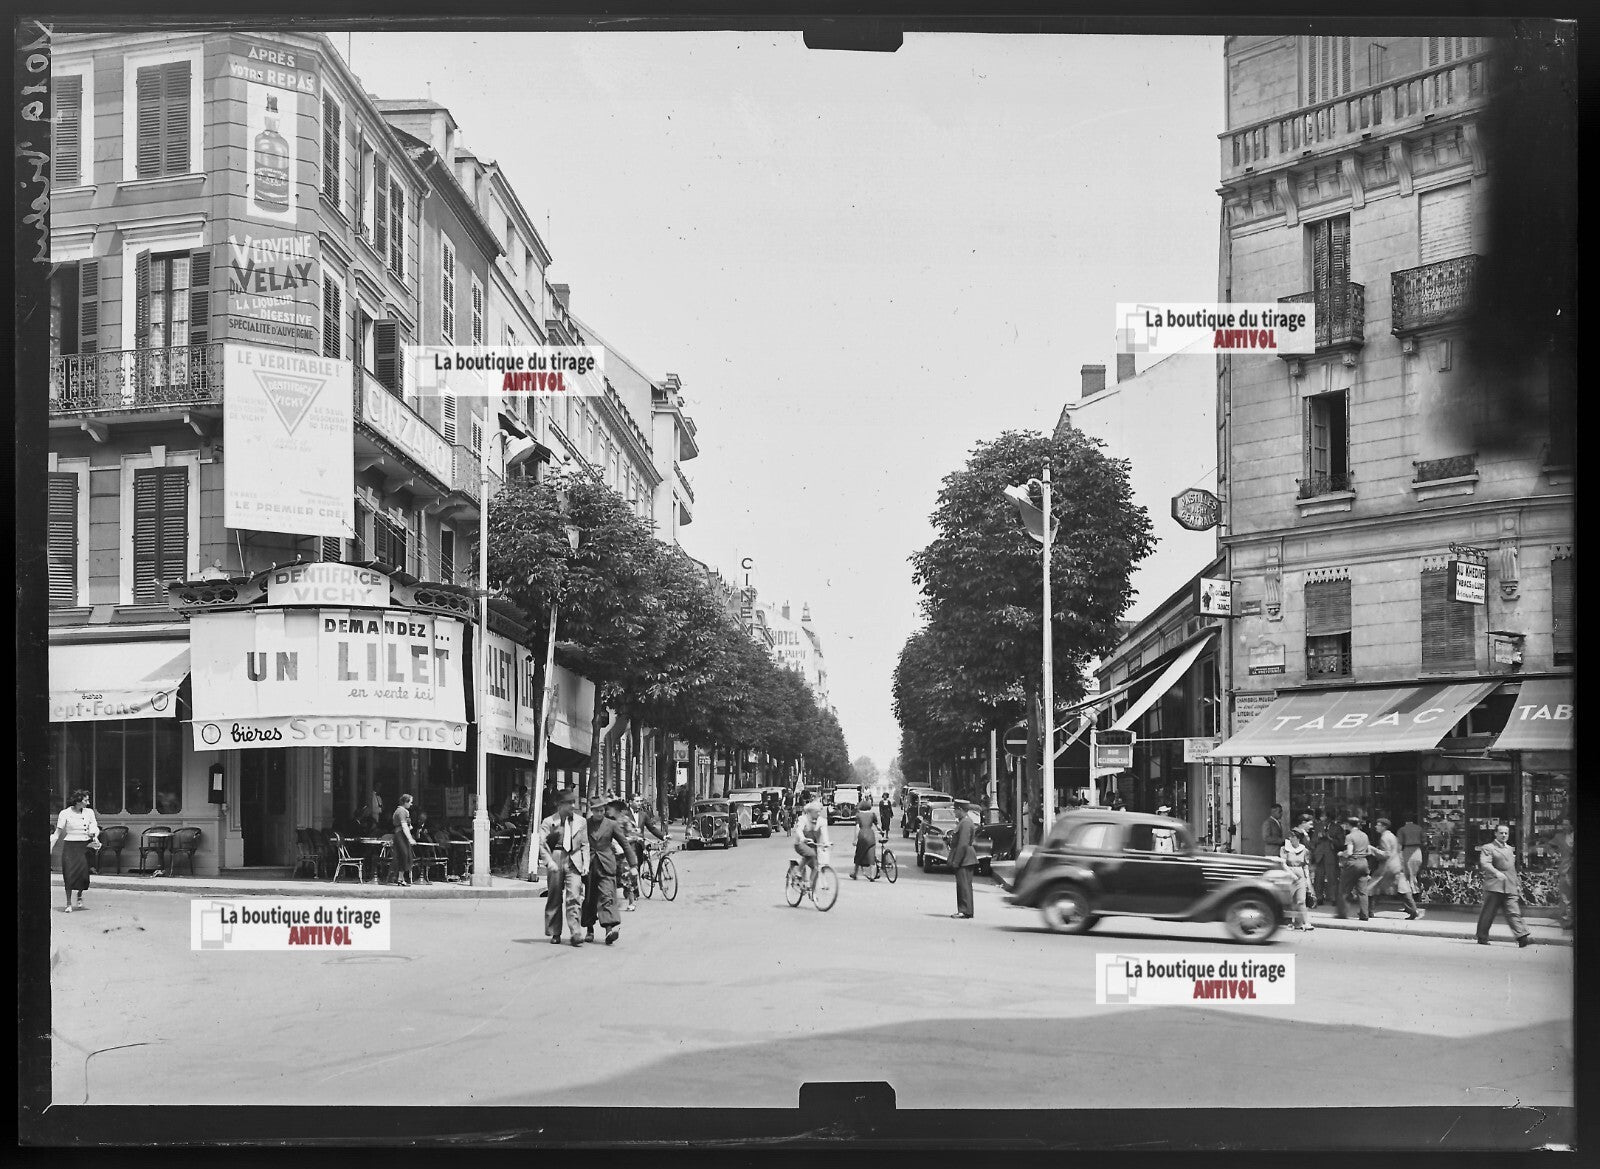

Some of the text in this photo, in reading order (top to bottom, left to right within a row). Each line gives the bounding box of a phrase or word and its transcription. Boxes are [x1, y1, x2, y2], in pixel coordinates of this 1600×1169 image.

[229, 63, 314, 92] VOTRE REPAS
[228, 234, 311, 268] VERVEINE
[231, 258, 313, 293] VELAY
[235, 294, 294, 311] LA LIQUEUR
[260, 308, 312, 326] DIGESTIVE
[237, 350, 253, 365] LE
[274, 394, 305, 408] VICHY
[367, 380, 445, 475] CINZANO
[234, 500, 250, 510] LE
[256, 502, 314, 516] PREMIER
[275, 567, 382, 586] DENTIFRICE
[292, 586, 373, 602] VICHY
[246, 651, 299, 681] UN
[347, 686, 434, 701] en vente ici
[1271, 707, 1447, 732] TABAC
